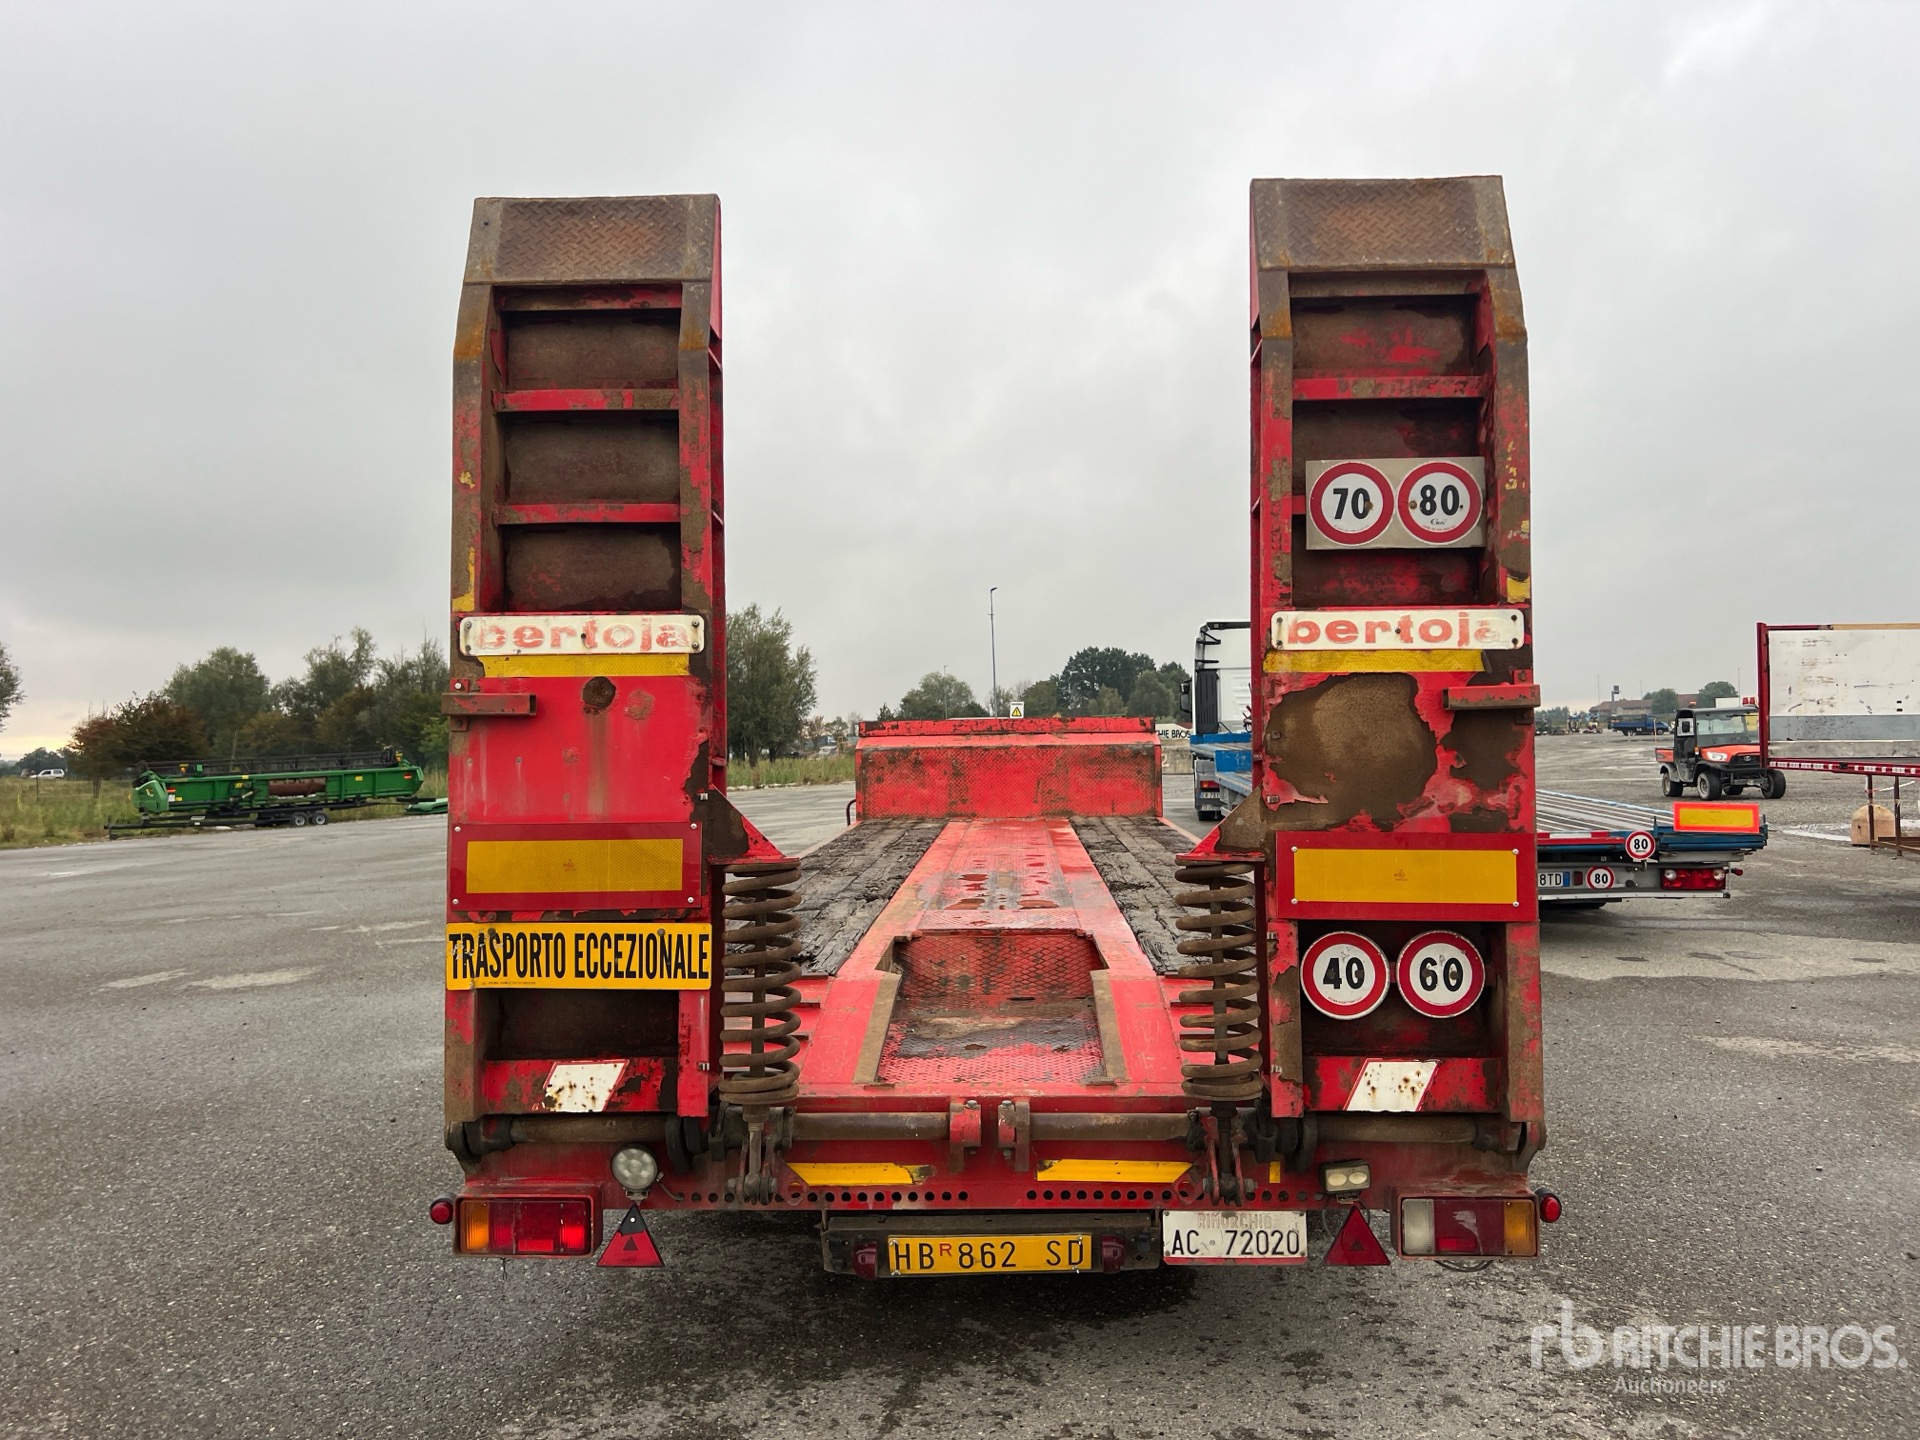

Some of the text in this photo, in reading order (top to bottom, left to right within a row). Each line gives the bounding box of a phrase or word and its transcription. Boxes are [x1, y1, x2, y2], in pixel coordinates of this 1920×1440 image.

[1333, 488, 1370, 520] 70
[1420, 484, 1459, 516] 80
[1633, 838, 1648, 850] 80
[1594, 873, 1608, 885] 80
[448, 931, 709, 980] TRASPORTO ECCEZIONALE
[1323, 957, 1365, 990] 40
[1419, 957, 1464, 992] 60
[1046, 1239, 1084, 1266] SD
[1172, 1230, 1299, 1255] AC 72020
